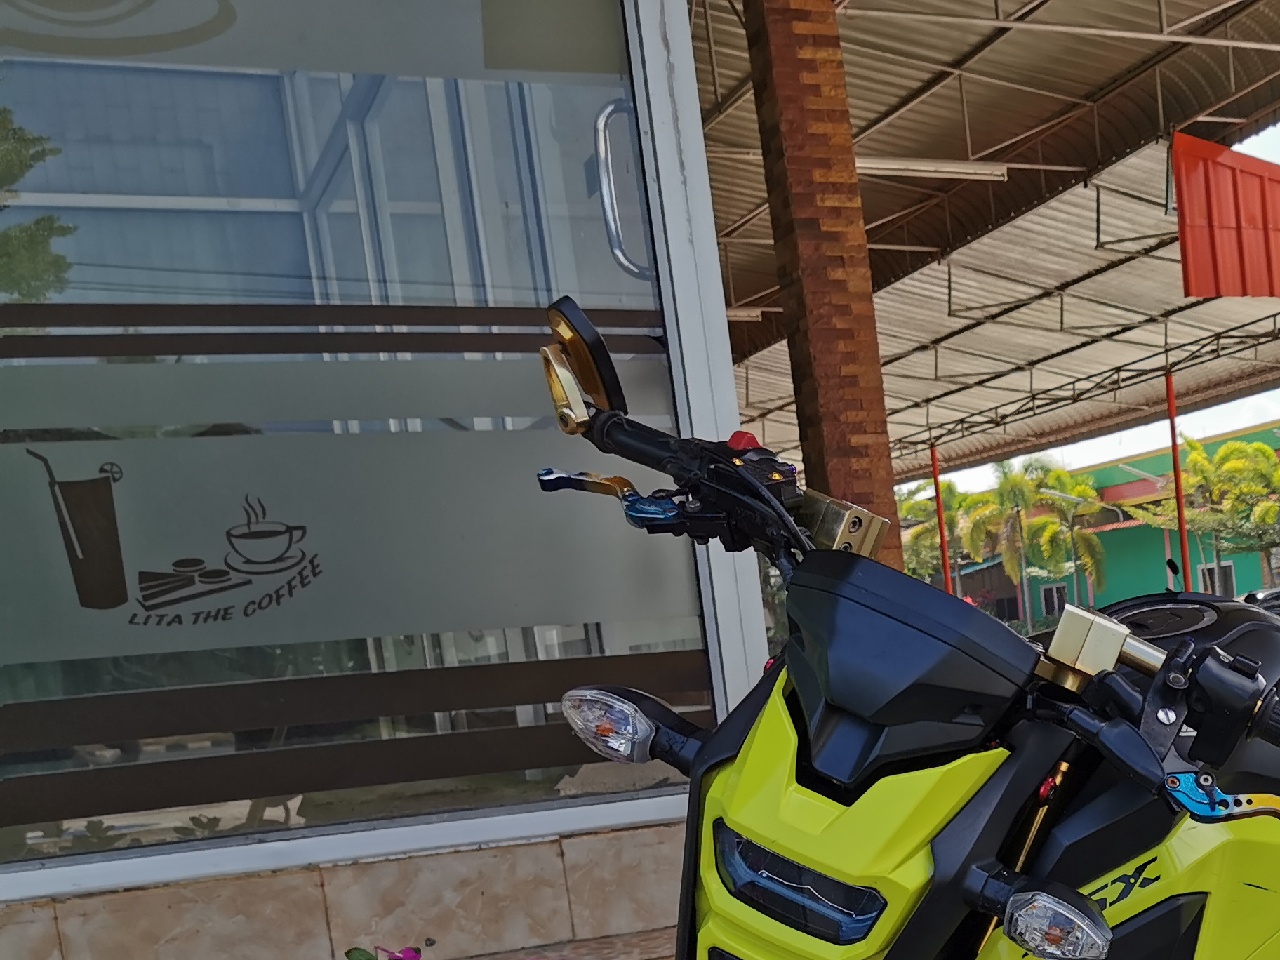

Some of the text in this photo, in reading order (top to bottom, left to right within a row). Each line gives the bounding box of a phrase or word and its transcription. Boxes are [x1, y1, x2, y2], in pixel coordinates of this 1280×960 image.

[128, 553, 323, 626] LITA THE COFFEE
